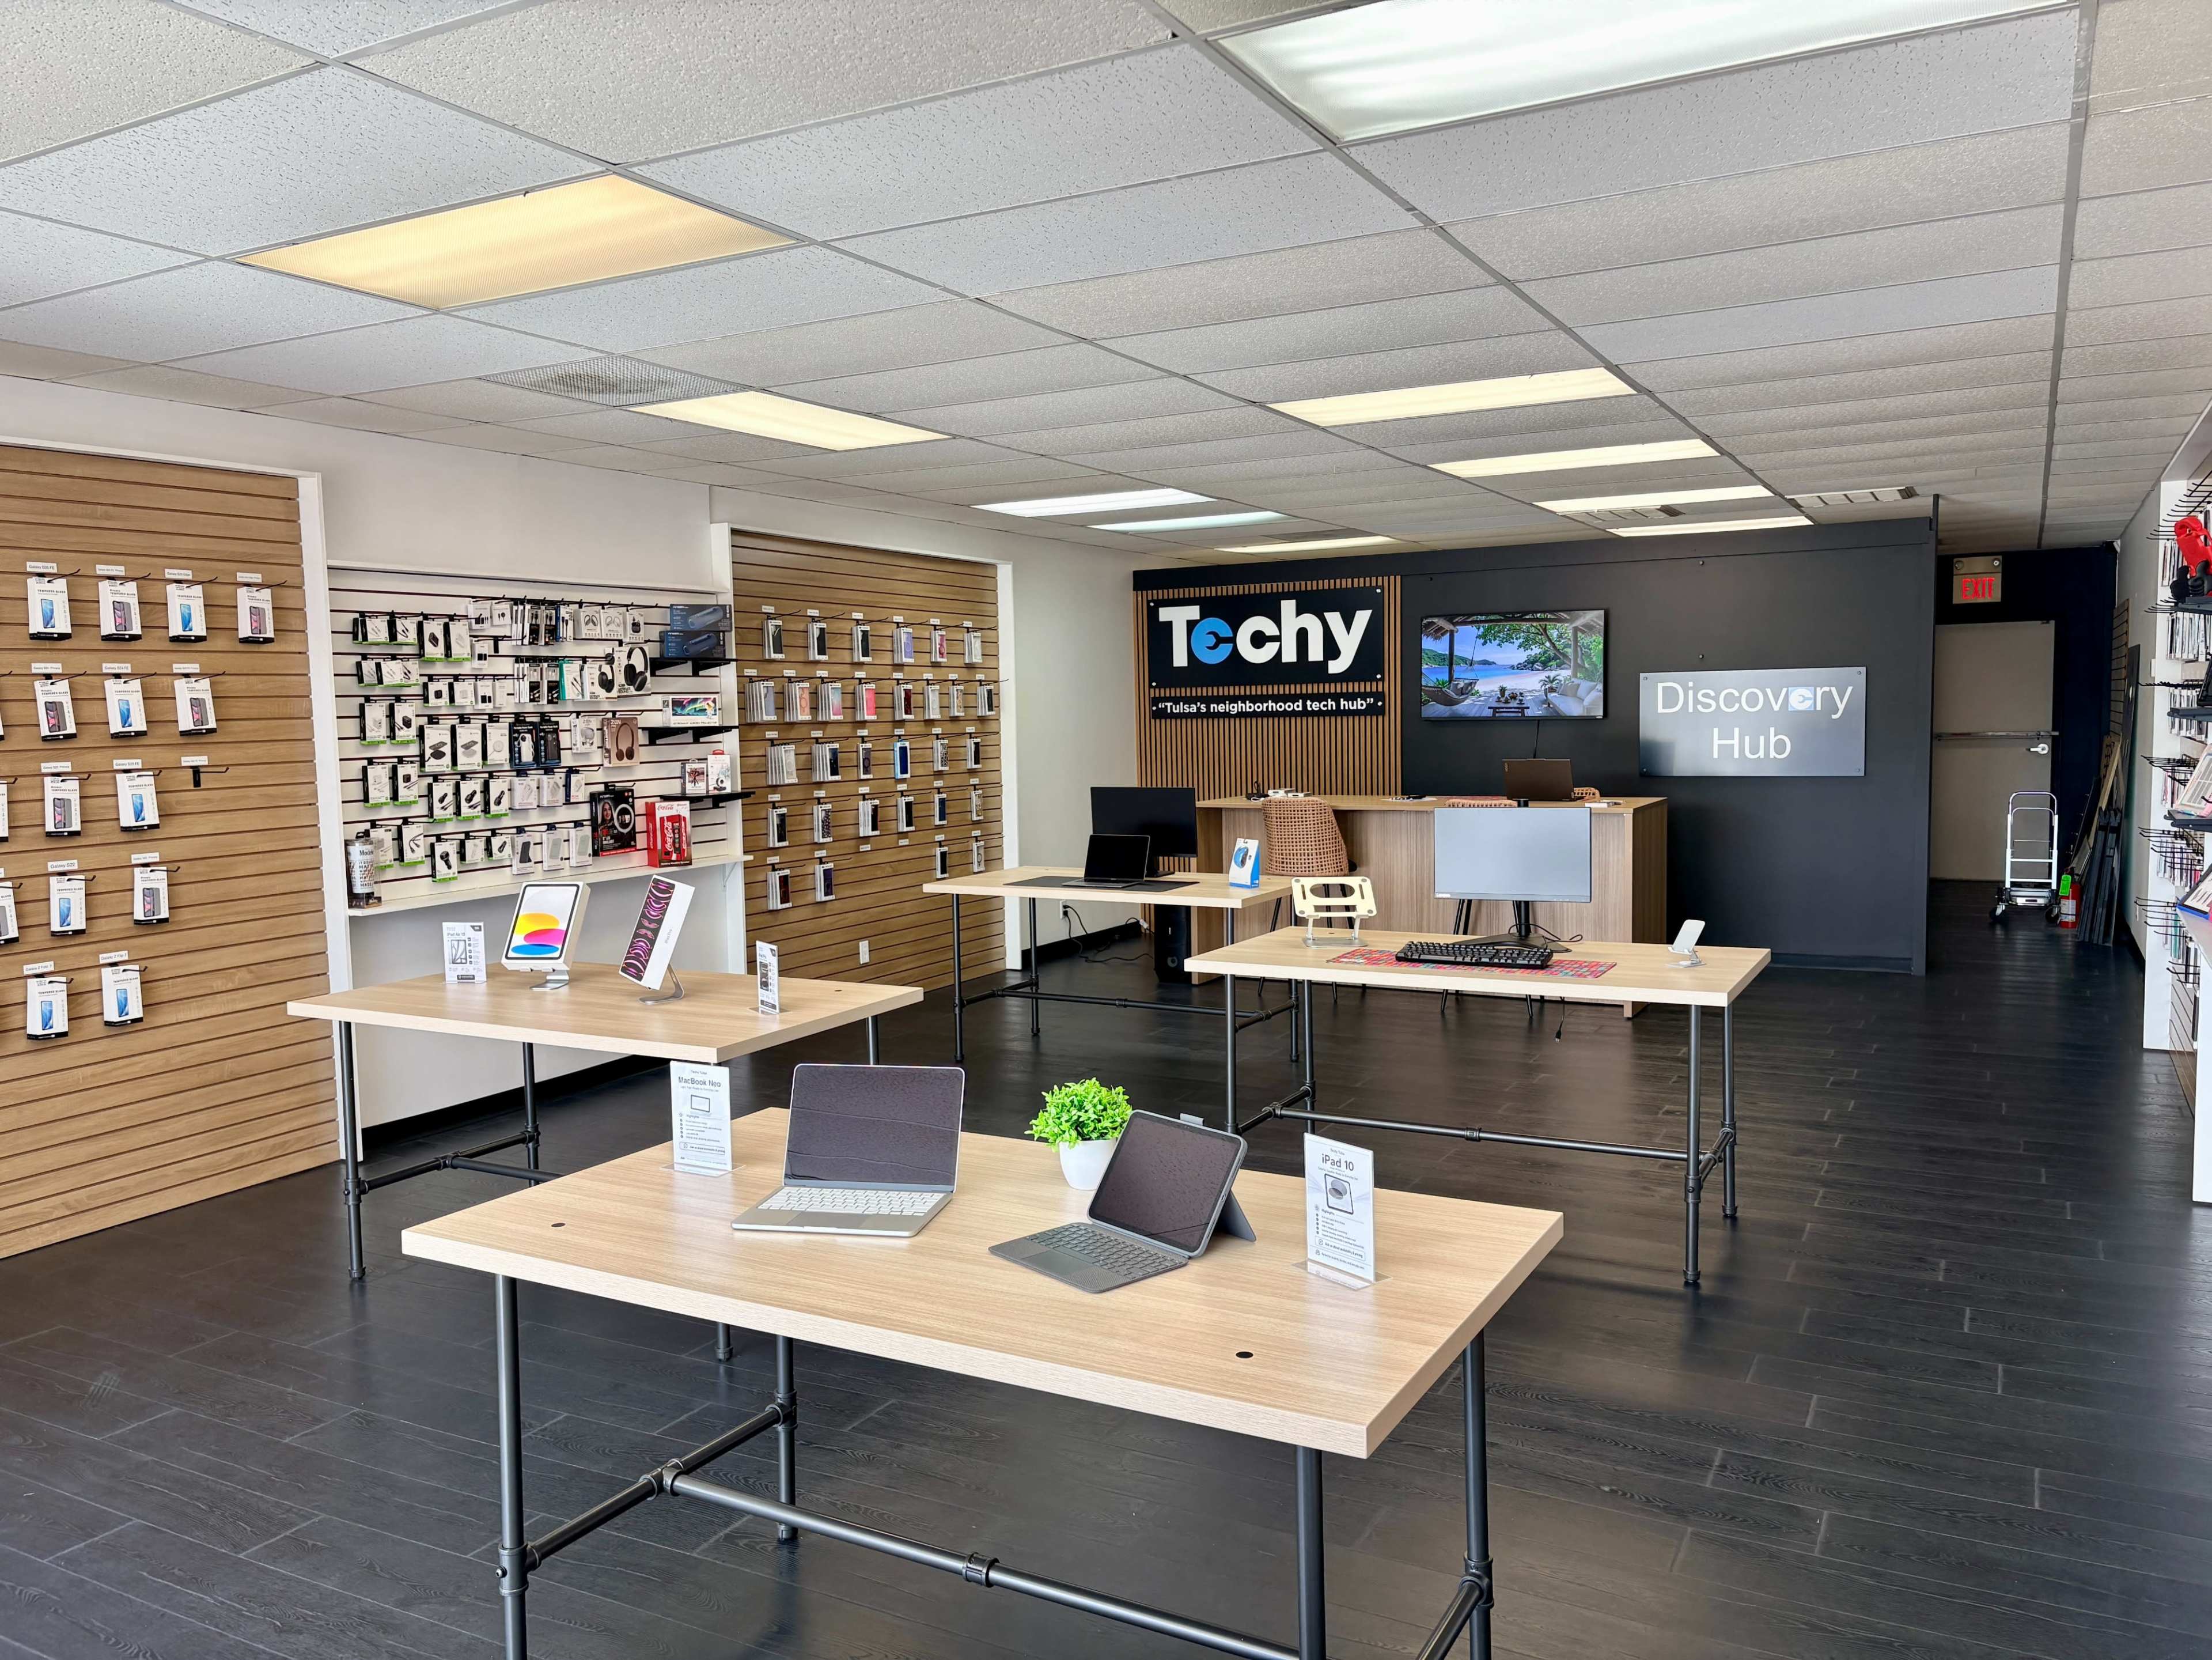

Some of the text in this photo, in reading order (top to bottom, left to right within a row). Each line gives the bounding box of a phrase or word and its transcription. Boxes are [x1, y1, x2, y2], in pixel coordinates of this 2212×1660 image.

[1962, 577, 1995, 600] EXIT
[1159, 599, 1373, 674] Techy
[1210, 699, 1302, 714] neighborhood
[1306, 699, 1336, 711] tech
[1657, 681, 1853, 720] Discovery
[1713, 727, 1792, 759] Hub
[678, 1076, 707, 1086] MacBook
[1321, 1153, 1354, 1171] iPad 10
